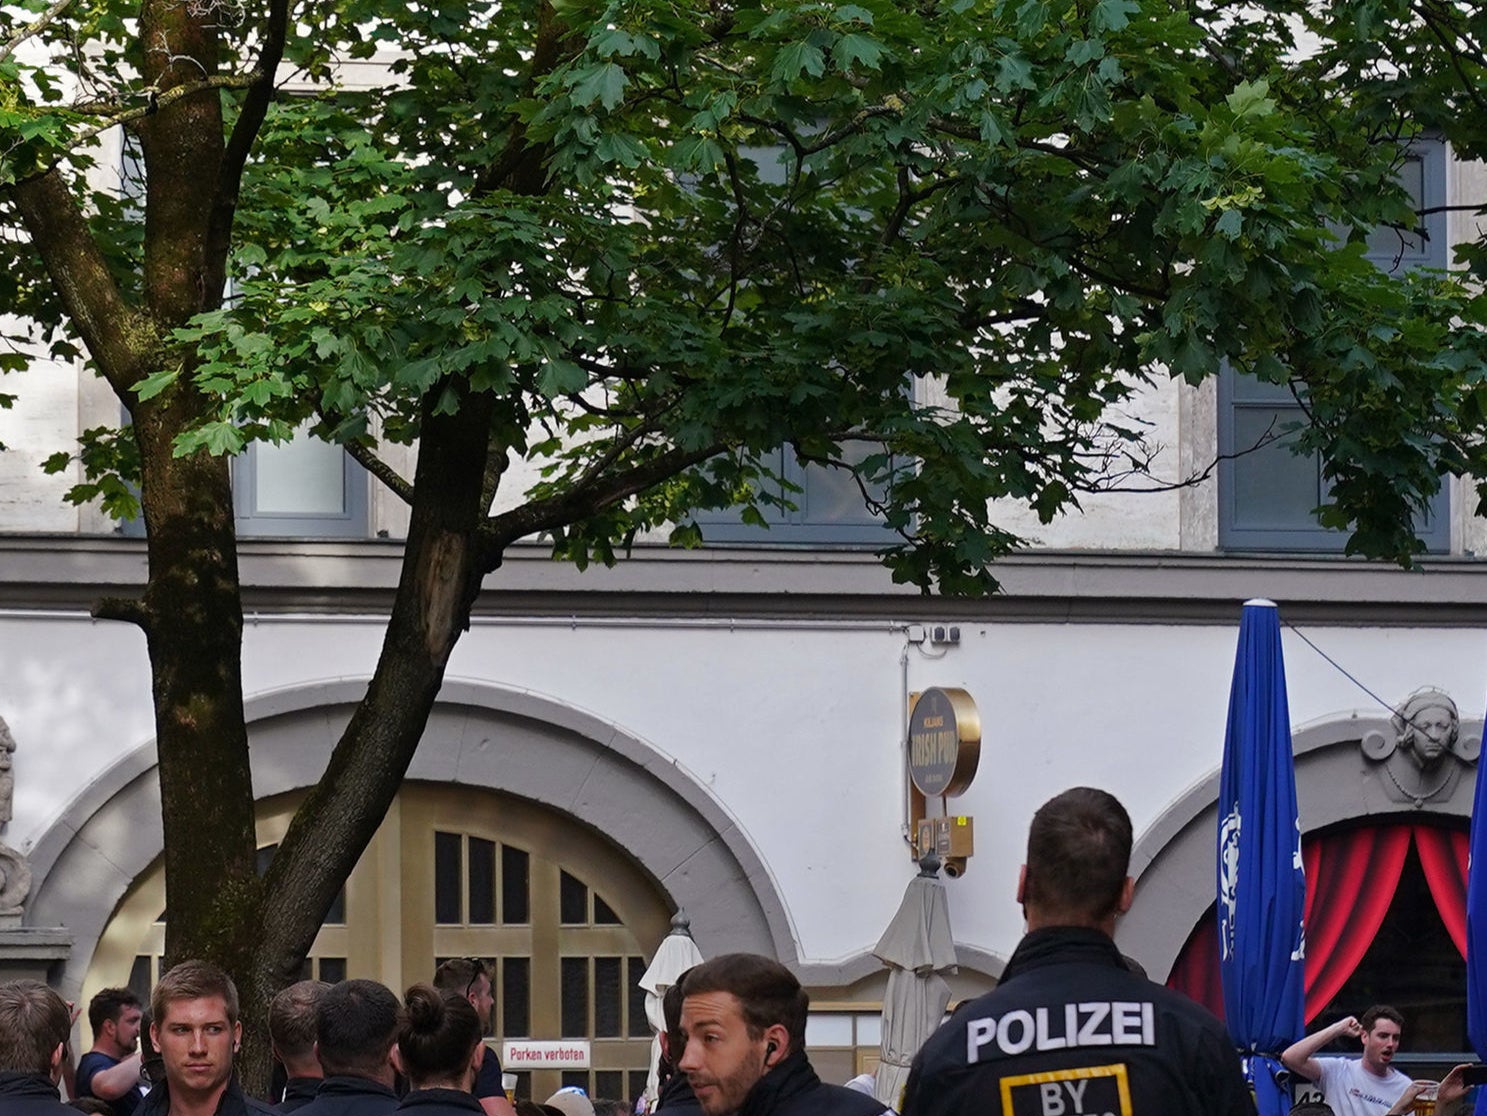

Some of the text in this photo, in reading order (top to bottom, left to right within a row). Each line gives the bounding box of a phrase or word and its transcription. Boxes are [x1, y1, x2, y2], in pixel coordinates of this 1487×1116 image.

[913, 730, 956, 767] IRISH PUB
[967, 1002, 1155, 1064] POLIZEI
[510, 1047, 584, 1060] Parken verboten
[1040, 1079, 1088, 1116] BY
